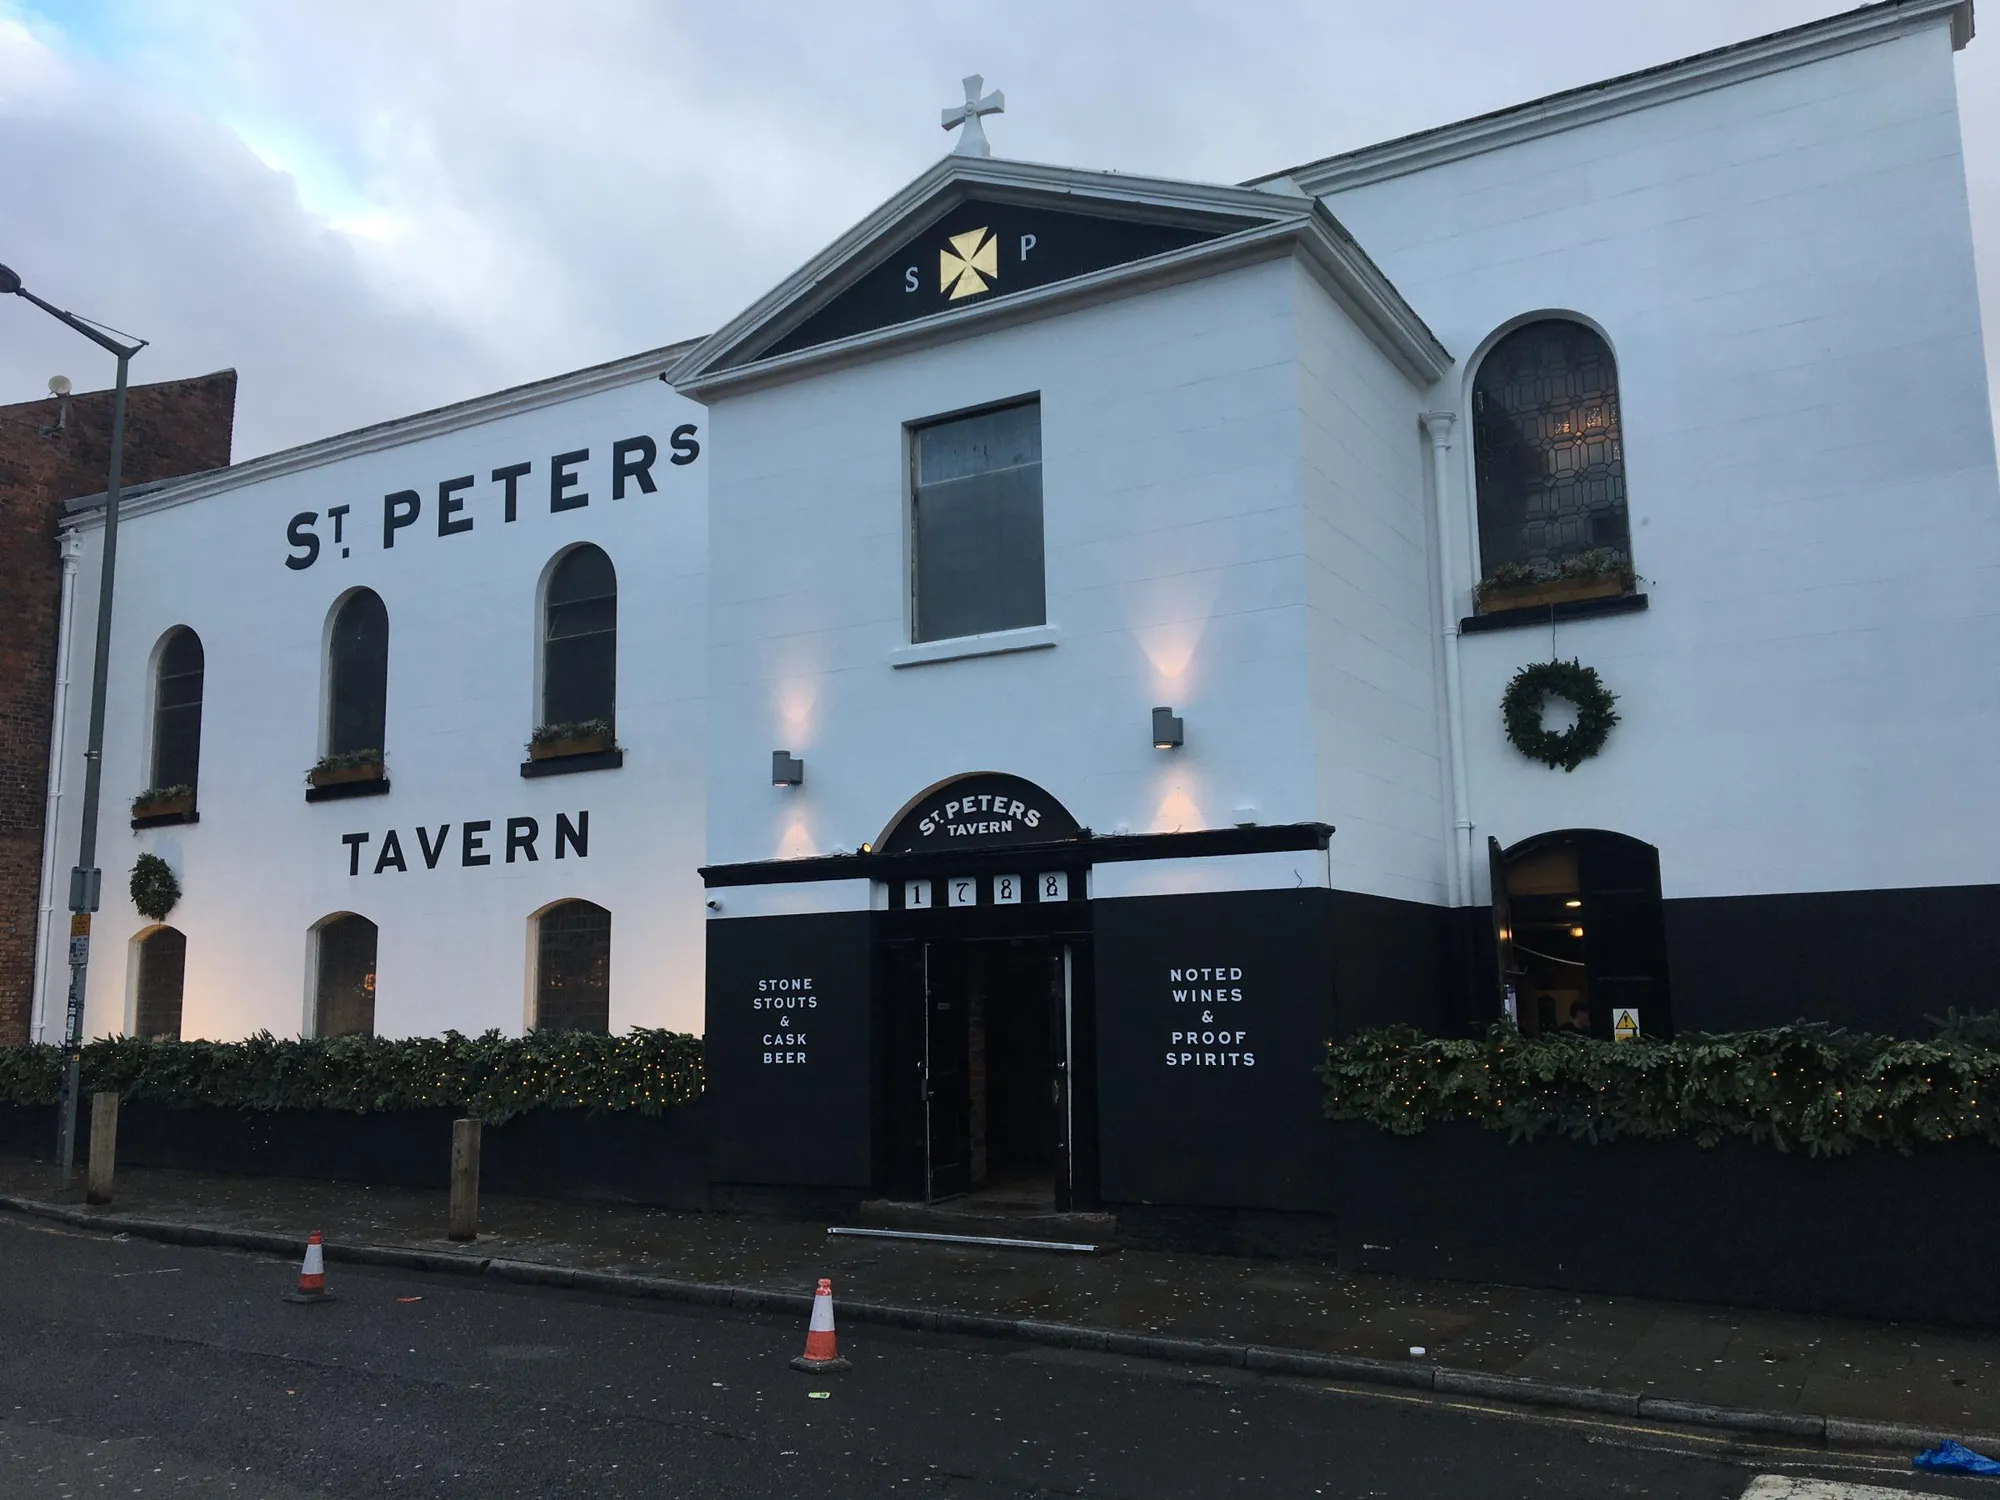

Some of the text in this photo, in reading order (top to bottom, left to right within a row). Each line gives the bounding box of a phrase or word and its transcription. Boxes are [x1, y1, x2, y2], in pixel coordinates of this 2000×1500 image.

[905, 233, 1037, 293] S P
[383, 423, 701, 550] PETERS
[945, 794, 1042, 828] PETERS
[946, 819, 1013, 837] TAVERN
[341, 810, 589, 877] TAVERN
[1170, 967, 1243, 982] NOTED
[758, 978, 813, 992] STONE
[753, 996, 818, 1010] STOUTS
[1172, 988, 1243, 1003] WINES
[780, 1015, 790, 1027] &
[1201, 1009, 1214, 1023] &
[763, 1033, 807, 1046] CASK
[1172, 1031, 1247, 1045] PROOF
[763, 1052, 807, 1064] BEER
[1166, 1052, 1256, 1067] SPIRITS
